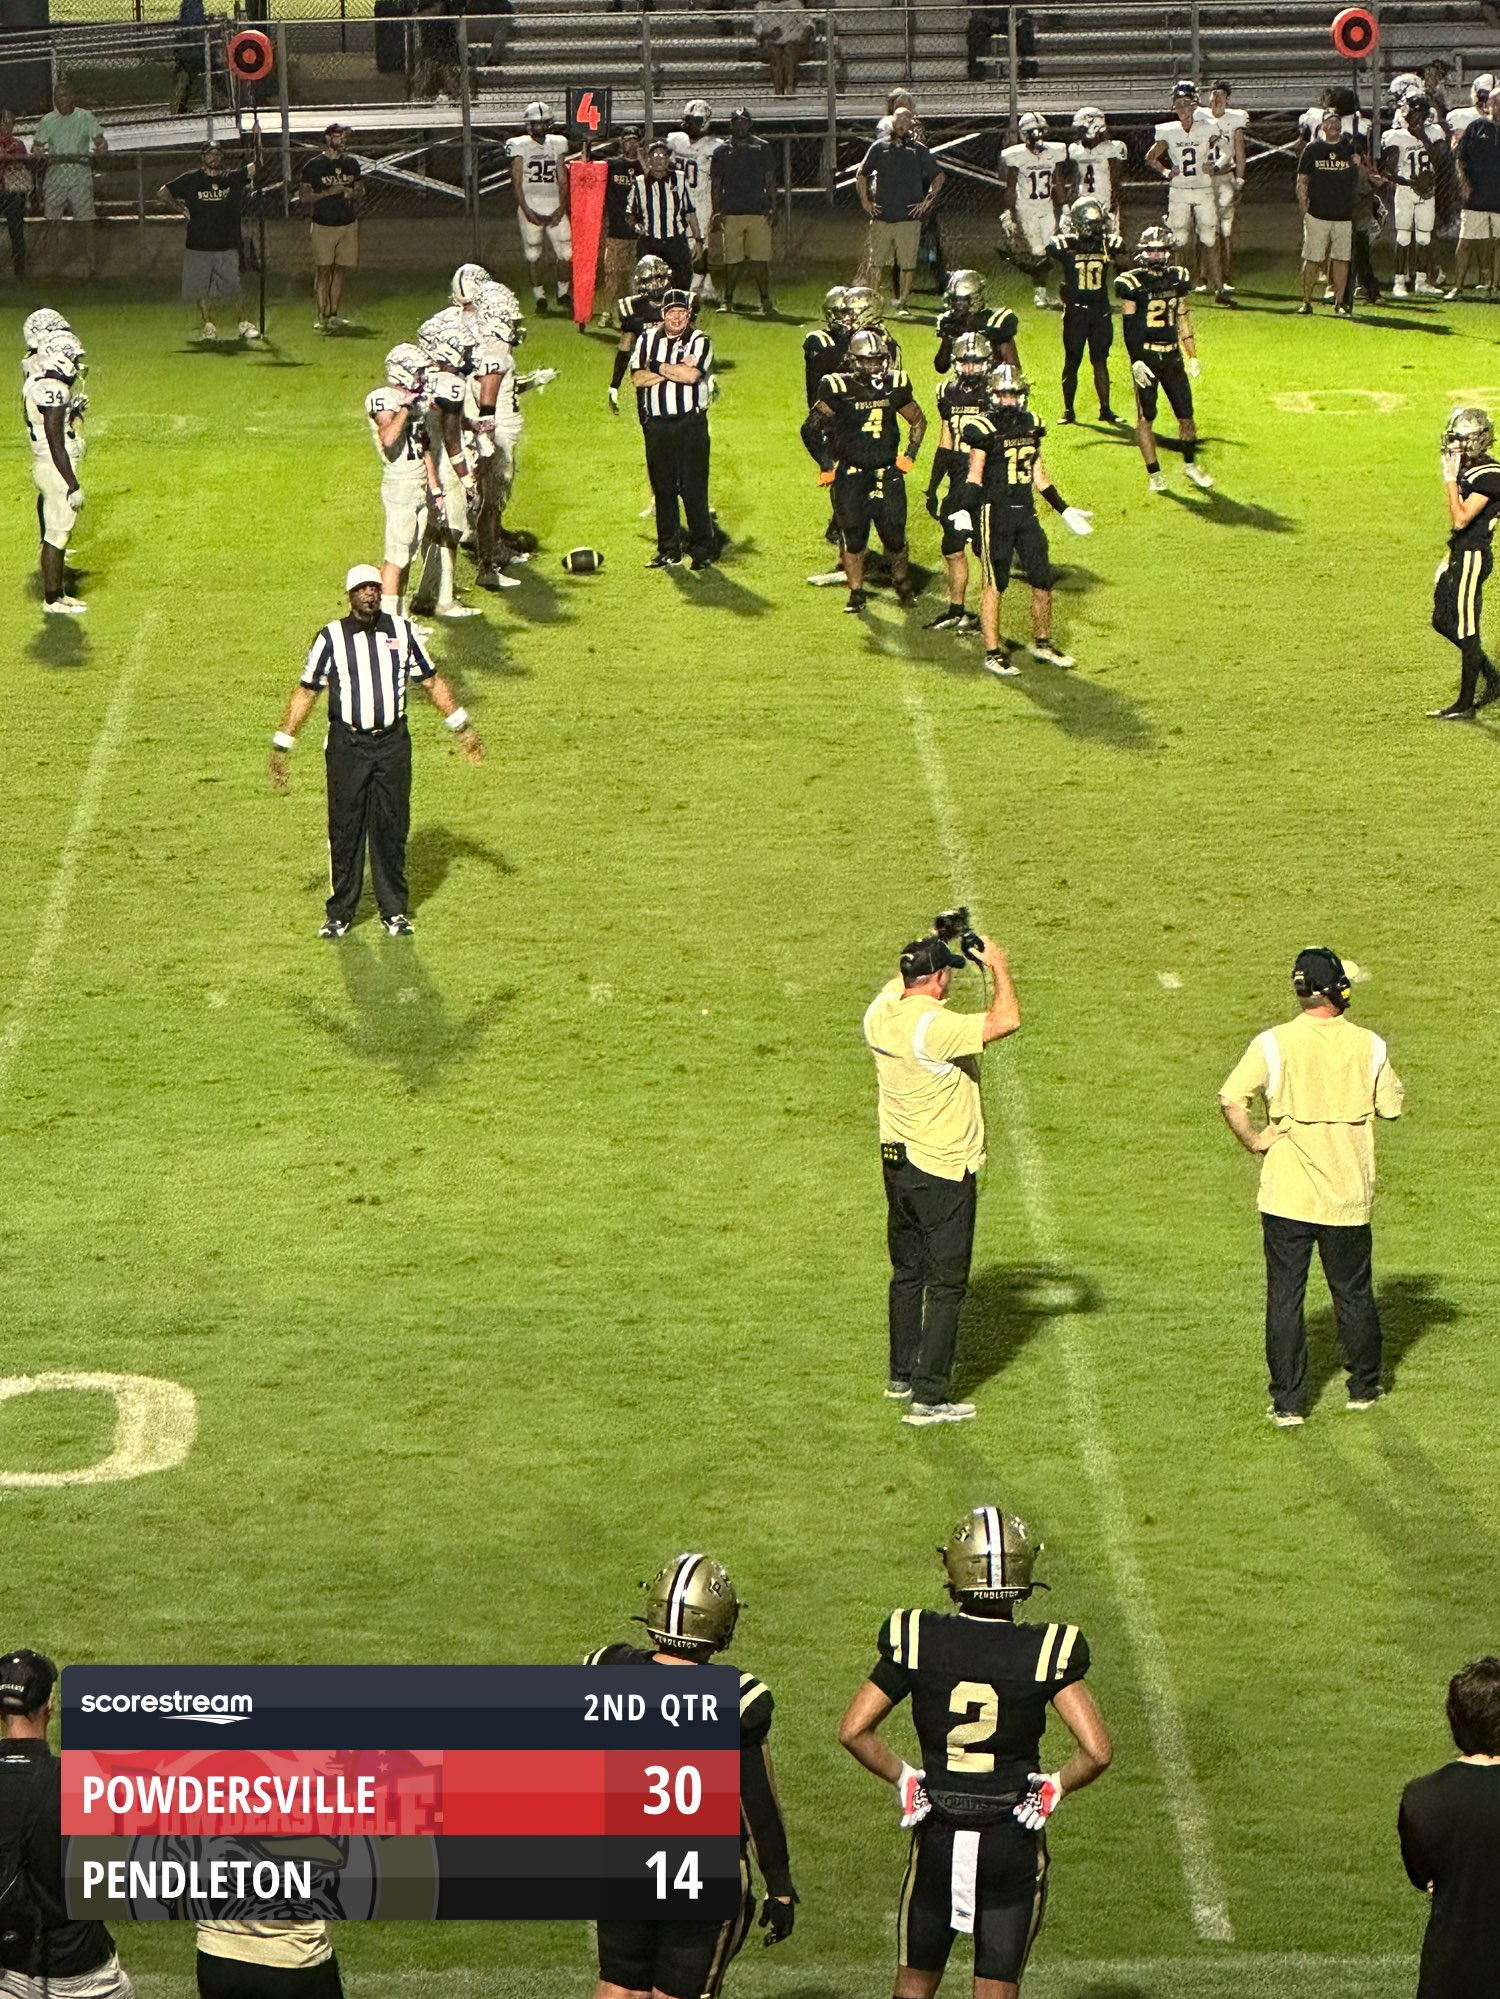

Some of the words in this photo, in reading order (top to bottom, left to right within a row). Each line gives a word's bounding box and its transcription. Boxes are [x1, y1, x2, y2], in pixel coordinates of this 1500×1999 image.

[576, 92, 601, 130] 4
[528, 161, 556, 183] 35
[1181, 147, 1196, 177] 2
[1028, 170, 1052, 199] 13
[1083, 163, 1095, 193] 4
[1074, 260, 1104, 291] 10
[1146, 299, 1178, 328] 21
[45, 390, 64, 404] 34
[370, 397, 386, 413] 15
[450, 385, 462, 399] 5
[861, 408, 884, 439] 4
[1004, 446, 1037, 485] 13
[972, 1590, 1019, 1600] PENDLETON
[654, 1634, 698, 1649] PENDLETON
[946, 1681, 999, 1773] 2
